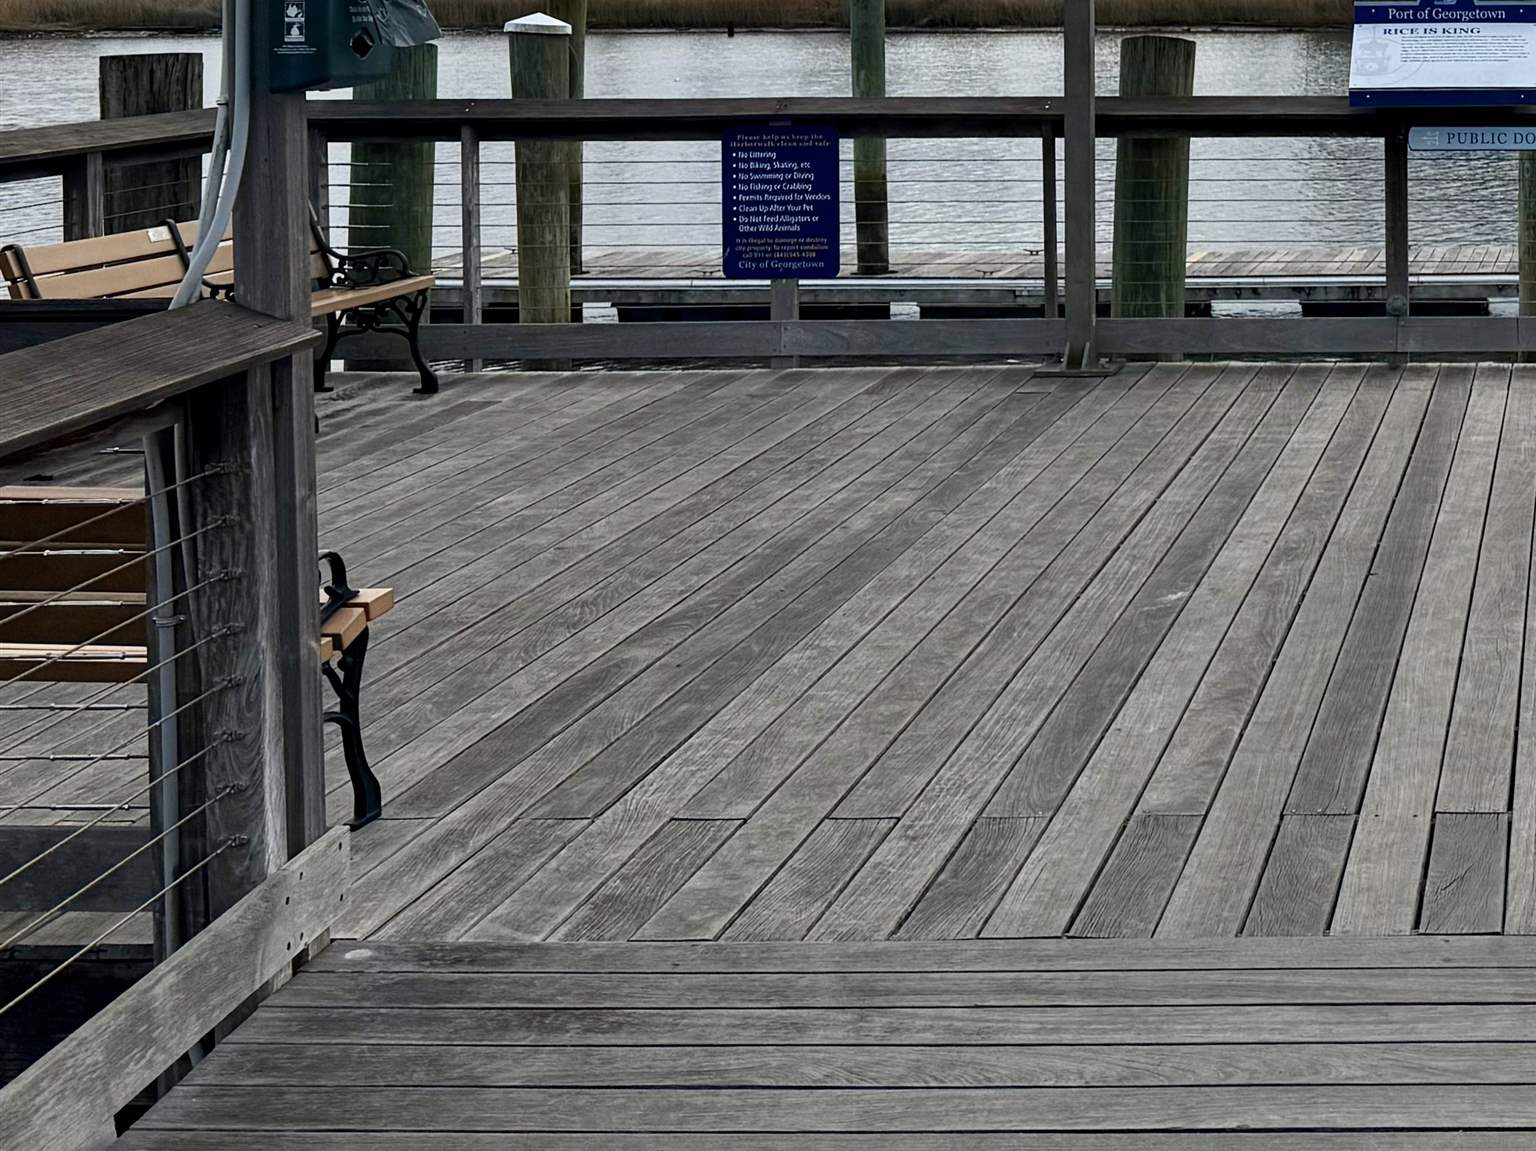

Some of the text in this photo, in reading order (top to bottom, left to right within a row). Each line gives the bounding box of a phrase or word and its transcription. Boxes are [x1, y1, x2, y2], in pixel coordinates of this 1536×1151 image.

[1388, 7, 1506, 22] Port of Georgetown
[1383, 27, 1482, 36] RICE IS KING
[1447, 132, 1508, 145] PUBLIC
[749, 151, 777, 160] Littering
[750, 172, 784, 181] Swimming
[794, 172, 815, 181] Diving
[738, 183, 749, 191] No
[750, 183, 773, 192] Fishing
[782, 182, 812, 191] Crabbing
[738, 193, 831, 202] Permits Required for Vendors
[739, 204, 758, 212] Clean
[759, 204, 769, 213] Up
[769, 204, 786, 212] After
[749, 215, 762, 223] Not
[779, 215, 811, 224] Alligators
[738, 224, 801, 233] Other Wild Animals
[738, 260, 825, 270] City of Georgetown
